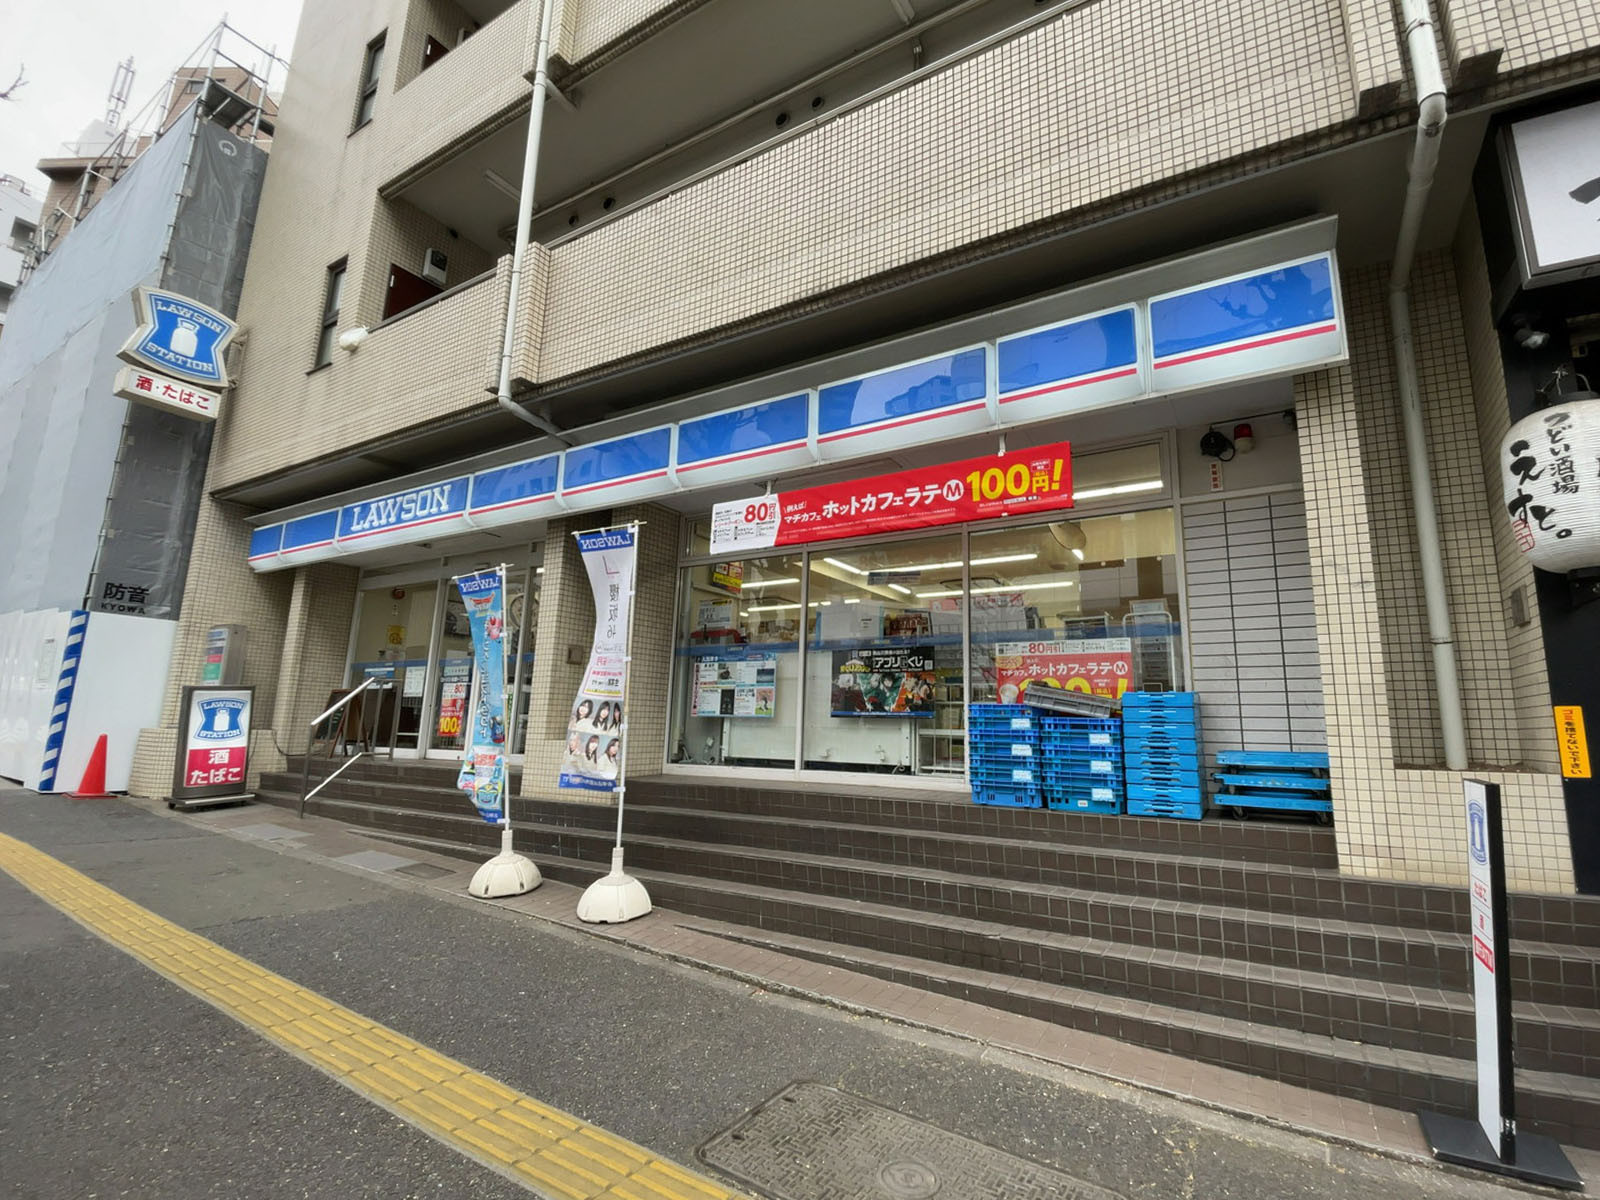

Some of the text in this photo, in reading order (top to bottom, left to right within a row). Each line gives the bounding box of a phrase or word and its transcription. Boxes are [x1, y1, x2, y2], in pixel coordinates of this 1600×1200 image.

[156, 301, 223, 334] LAWSON
[145, 342, 214, 373] STATION
[350, 485, 452, 532] LAWSON
[822, 484, 942, 518] ホットカフェラテ
[783, 512, 822, 524] マチカフェ
[103, 582, 150, 604] 防音
[101, 602, 145, 615] KYOWA
[1029, 661, 1112, 677] ホットカフェラテ
[208, 749, 231, 764] 酒
[190, 767, 241, 785] たばこ
